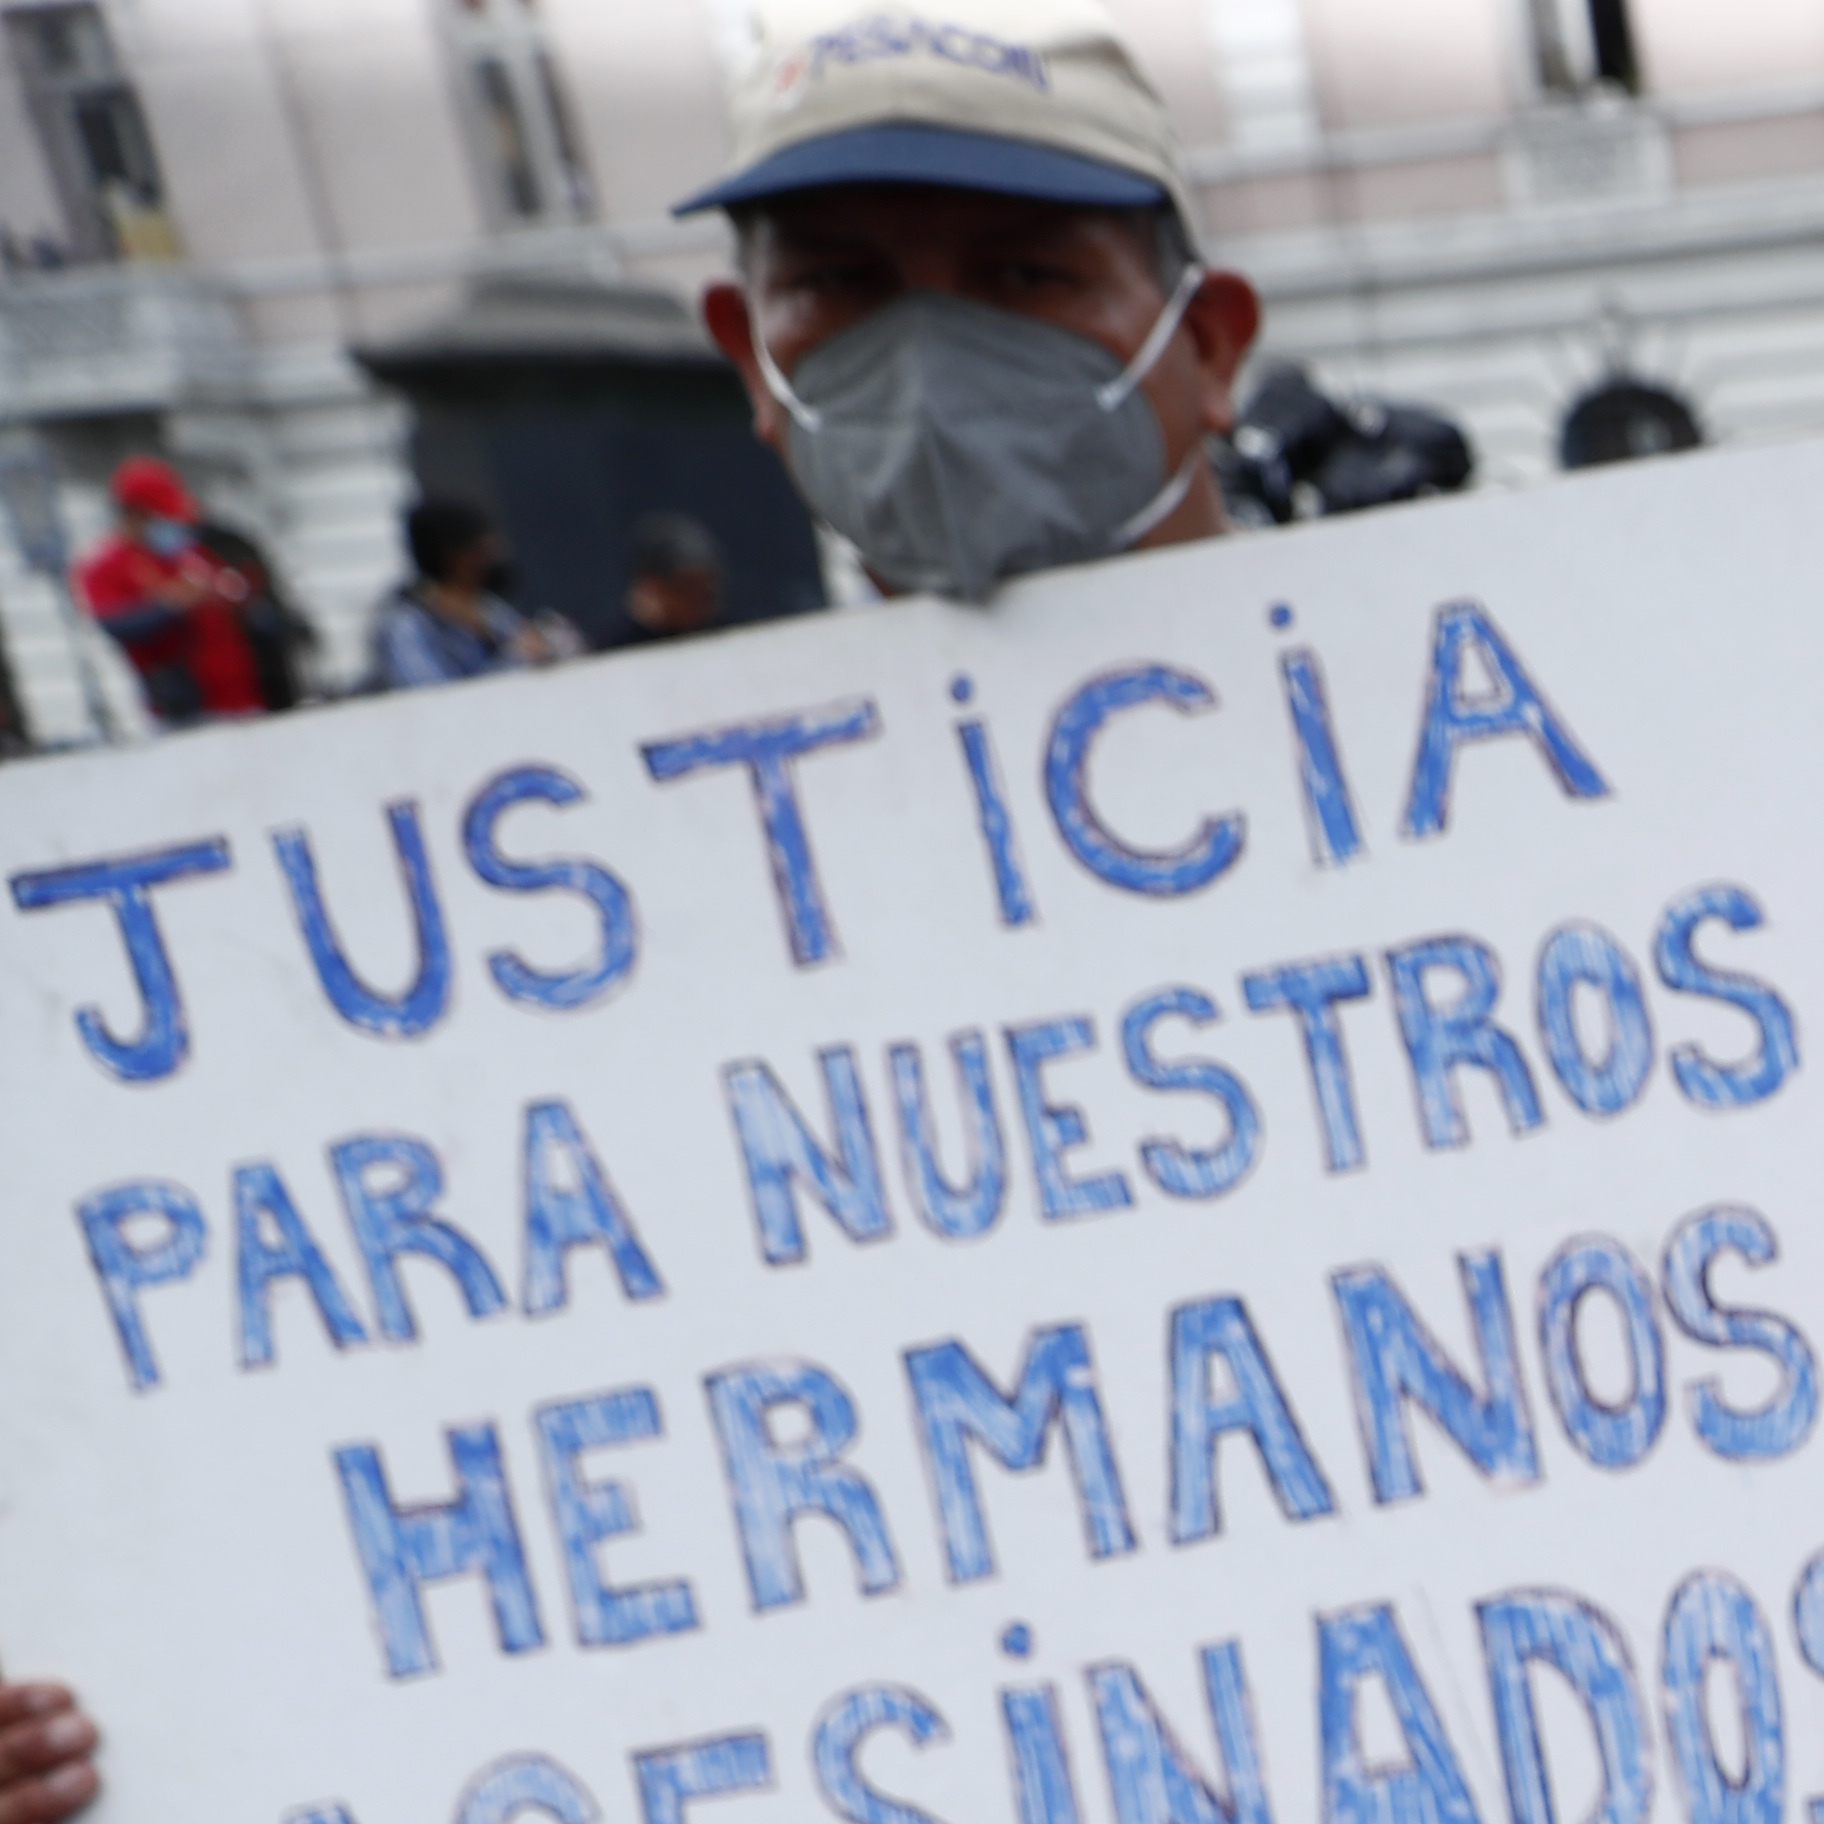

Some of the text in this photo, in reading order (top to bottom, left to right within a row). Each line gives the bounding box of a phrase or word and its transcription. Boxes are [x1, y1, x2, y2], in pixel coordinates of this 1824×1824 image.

[75, 886, 1802, 1388] PARA NUESTROS
[331, 1213, 1821, 1679] HERMANOS
